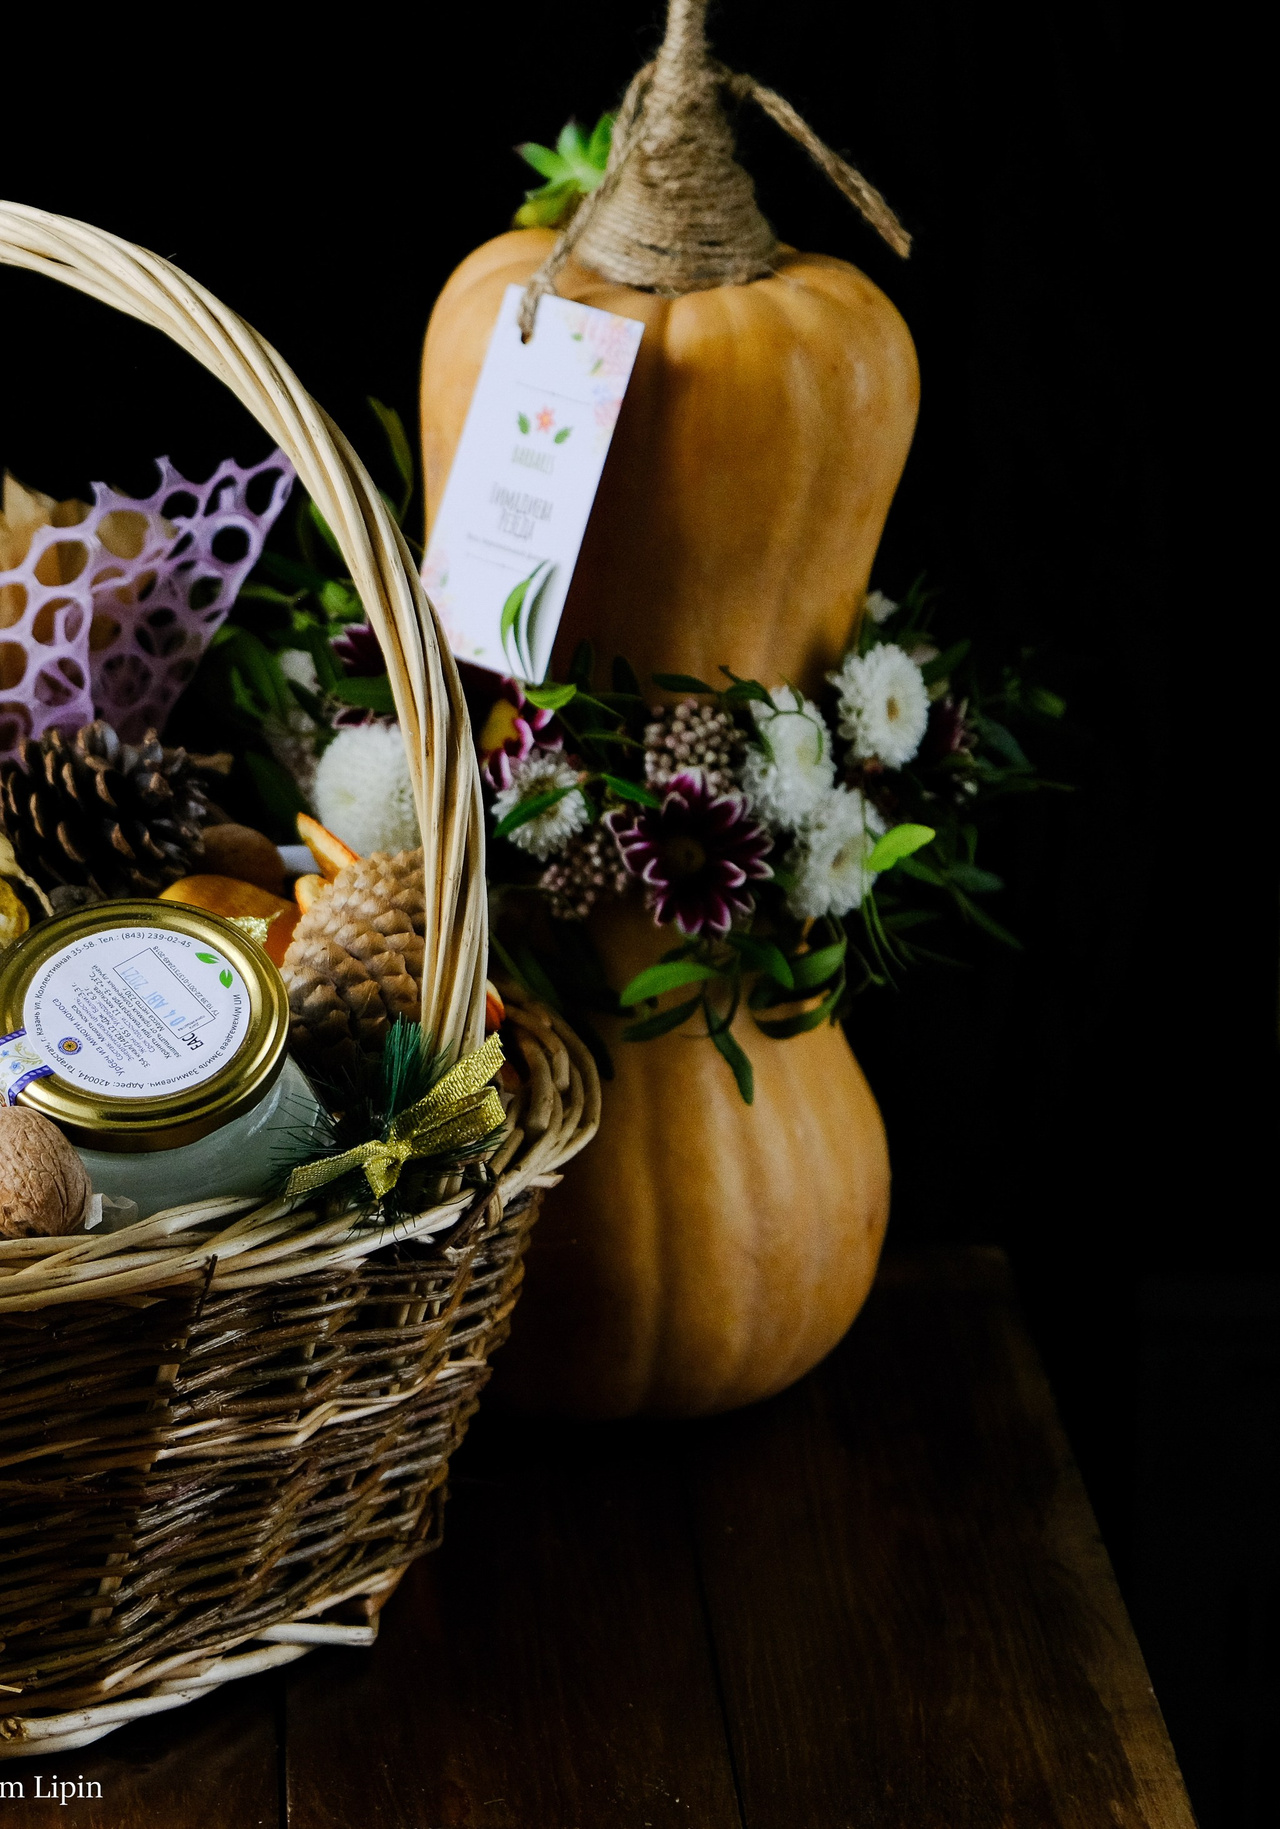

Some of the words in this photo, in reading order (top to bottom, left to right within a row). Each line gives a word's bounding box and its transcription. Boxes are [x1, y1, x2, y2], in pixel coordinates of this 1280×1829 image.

[121, 932, 145, 941] (843)
[147, 932, 192, 948] 239-02-45
[91, 964, 109, 980] лучей
[106, 980, 134, 1008] солнечных
[124, 990, 137, 1002] 230
[232, 994, 242, 1005] ИП
[52, 998, 76, 1022] кокоса
[71, 1004, 89, 1023] кокоса
[111, 1008, 122, 1016] 12
[111, 996, 143, 1029] температуре
[134, 1000, 151, 1015] нетто
[211, 1009, 220, 1017] ТУ
[131, 1007, 152, 1028] прямых
[148, 1014, 166, 1032] Масса
[73, 1021, 98, 1047] мякоти
[96, 1022, 135, 1061] Энергетическая
[121, 1029, 132, 1038] 65
[140, 1028, 153, 1039] при
[95, 1046, 107, 1056] из
[142, 1039, 156, 1053] Срок
[151, 1037, 172, 1060] Хранить
[157, 1033, 182, 1058] защищать
[104, 1055, 125, 1077] Урбеч
[138, 1057, 151, 1068] 354
[198, 1050, 224, 1069] Эмиль
